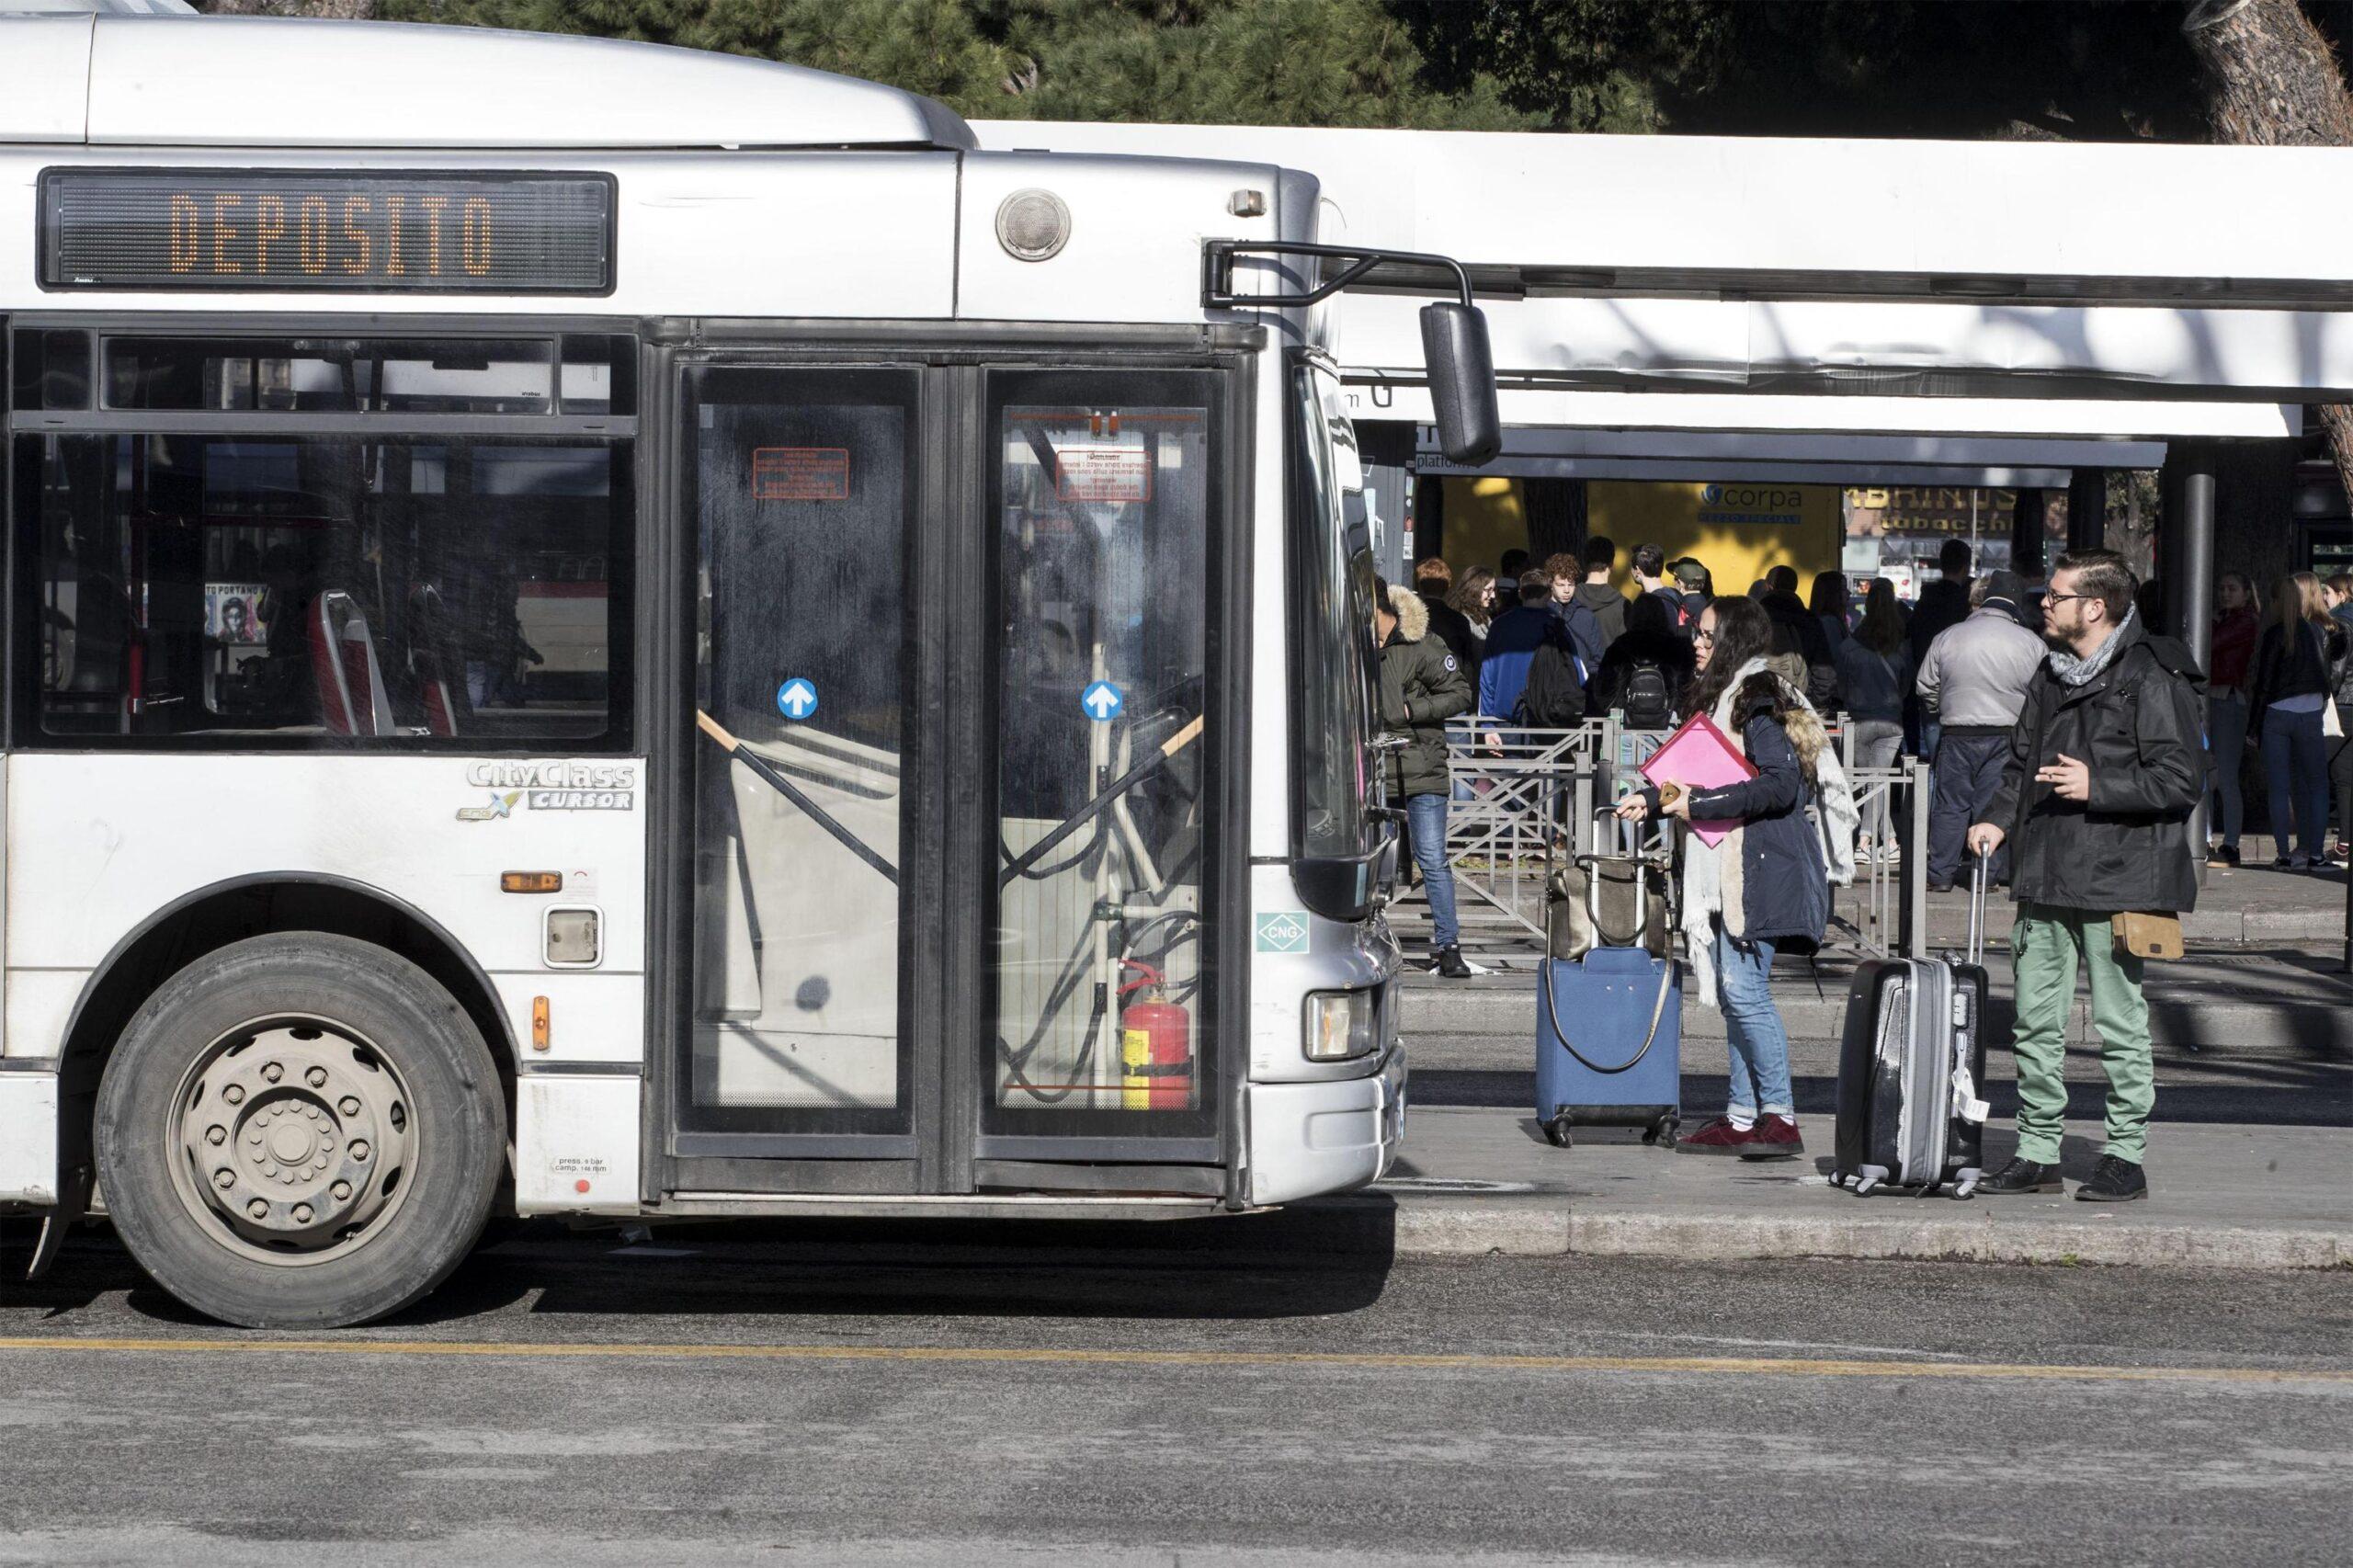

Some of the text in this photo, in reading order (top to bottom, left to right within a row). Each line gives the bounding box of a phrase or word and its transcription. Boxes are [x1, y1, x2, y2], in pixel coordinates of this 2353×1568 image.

[170, 194, 491, 276] DEPOSITO
[1416, 454, 1471, 470] platfo
[1723, 488, 1802, 511] corpa
[218, 585, 258, 596] PORTANO
[531, 792, 631, 809] CURSOR
[1267, 926, 1298, 938] CNG
